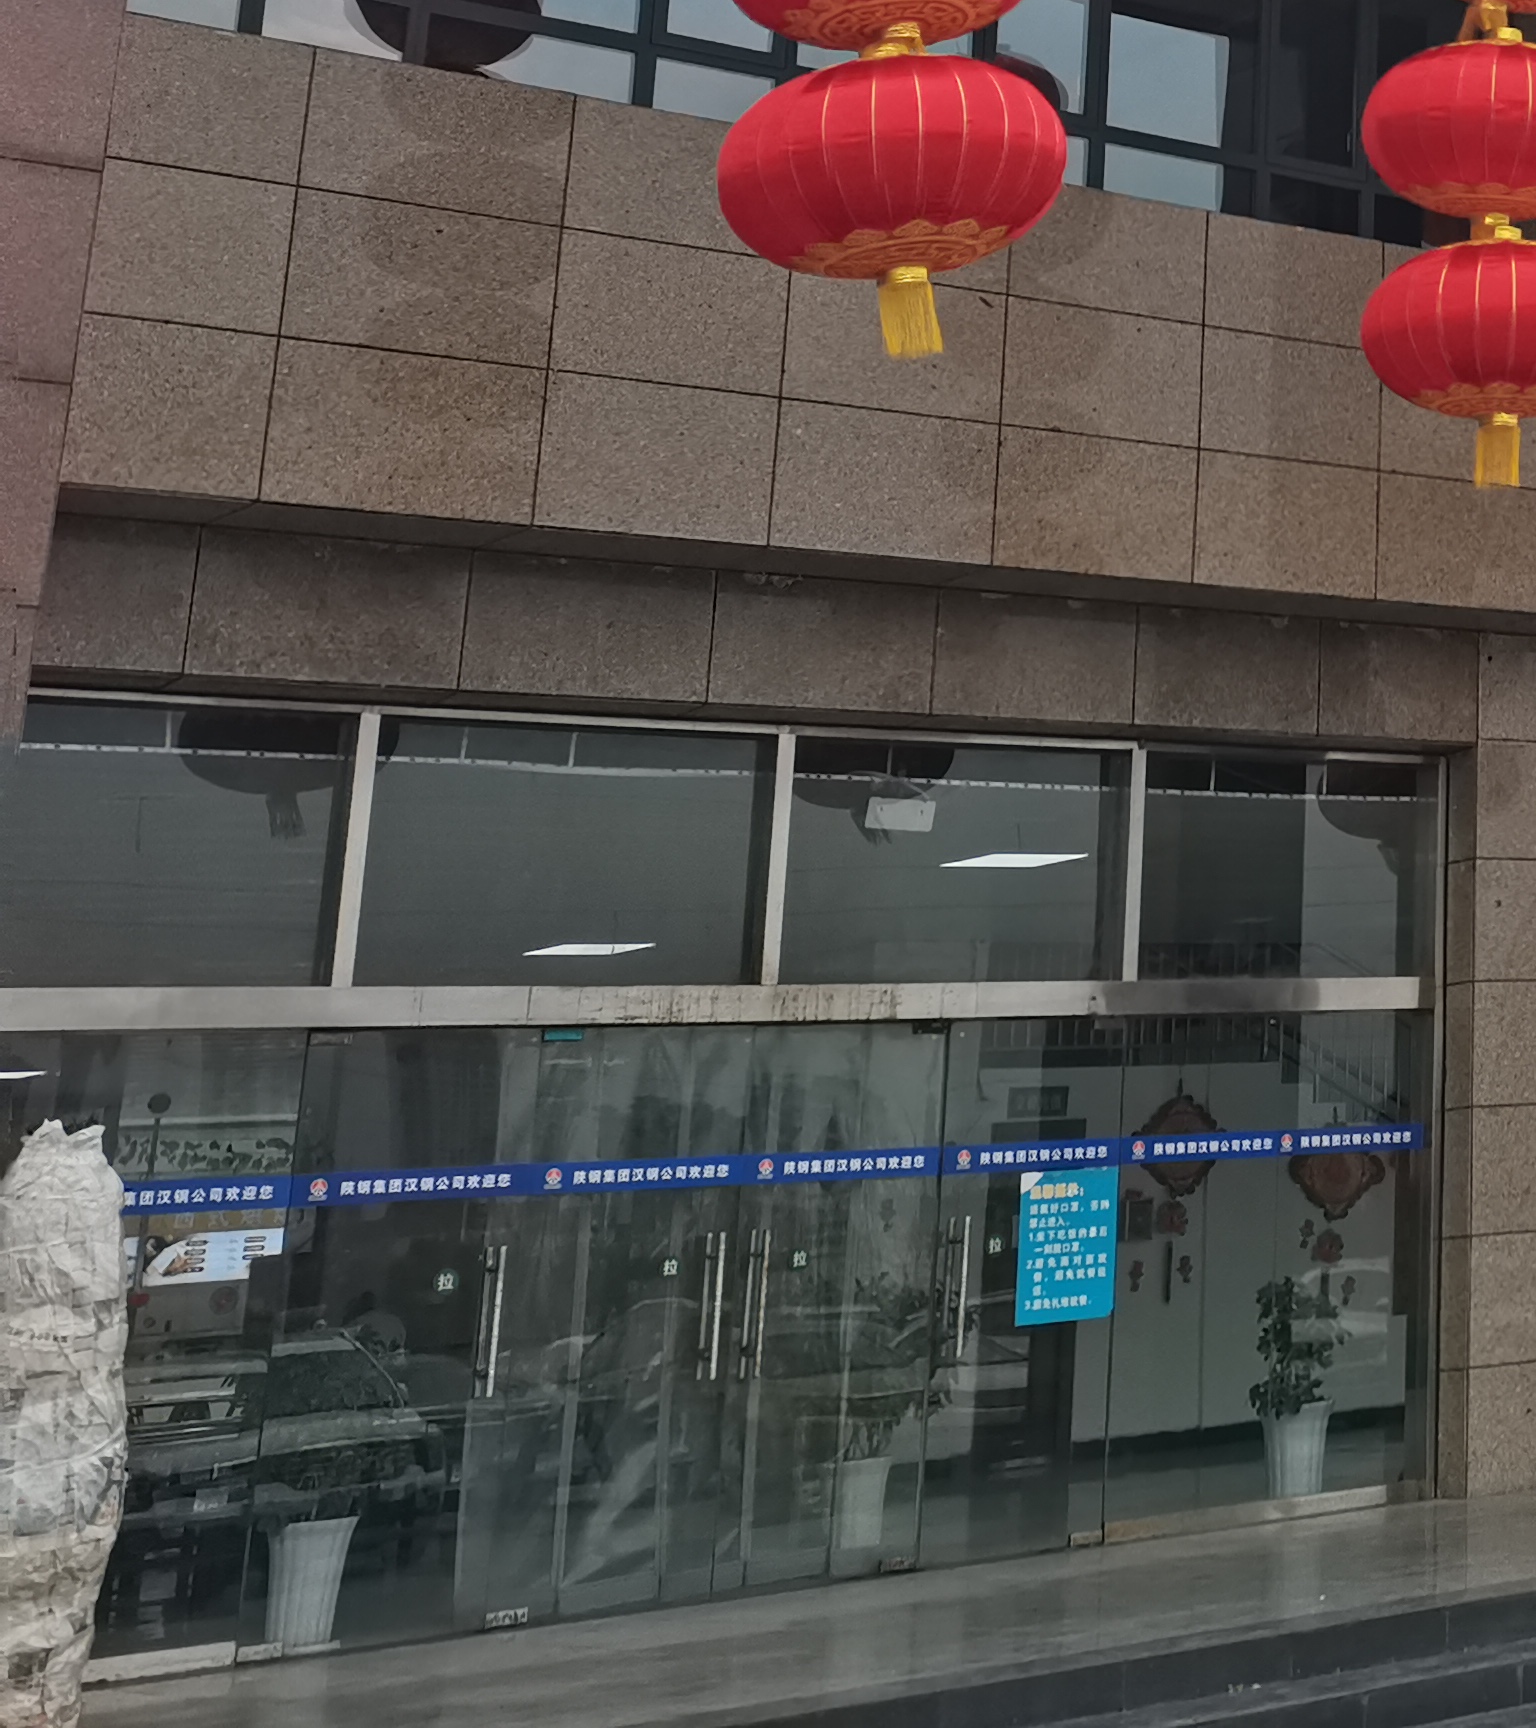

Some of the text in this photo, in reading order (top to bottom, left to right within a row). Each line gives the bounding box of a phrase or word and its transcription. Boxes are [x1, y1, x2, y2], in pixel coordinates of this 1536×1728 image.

[783, 1155, 926, 1176] 陕钢集团汉钢公司欢迎您
[979, 1145, 1108, 1166] 陕钢集团汉钢公司欢迎您
[339, 1173, 512, 1197] 陕钢集团汉钢公司欢迎您
[572, 1164, 730, 1186] 陕钢集团汉钢公司欢迎您
[663, 1259, 679, 1276] 拉
[793, 1251, 808, 1268] 拉
[437, 1273, 455, 1291] 拉
